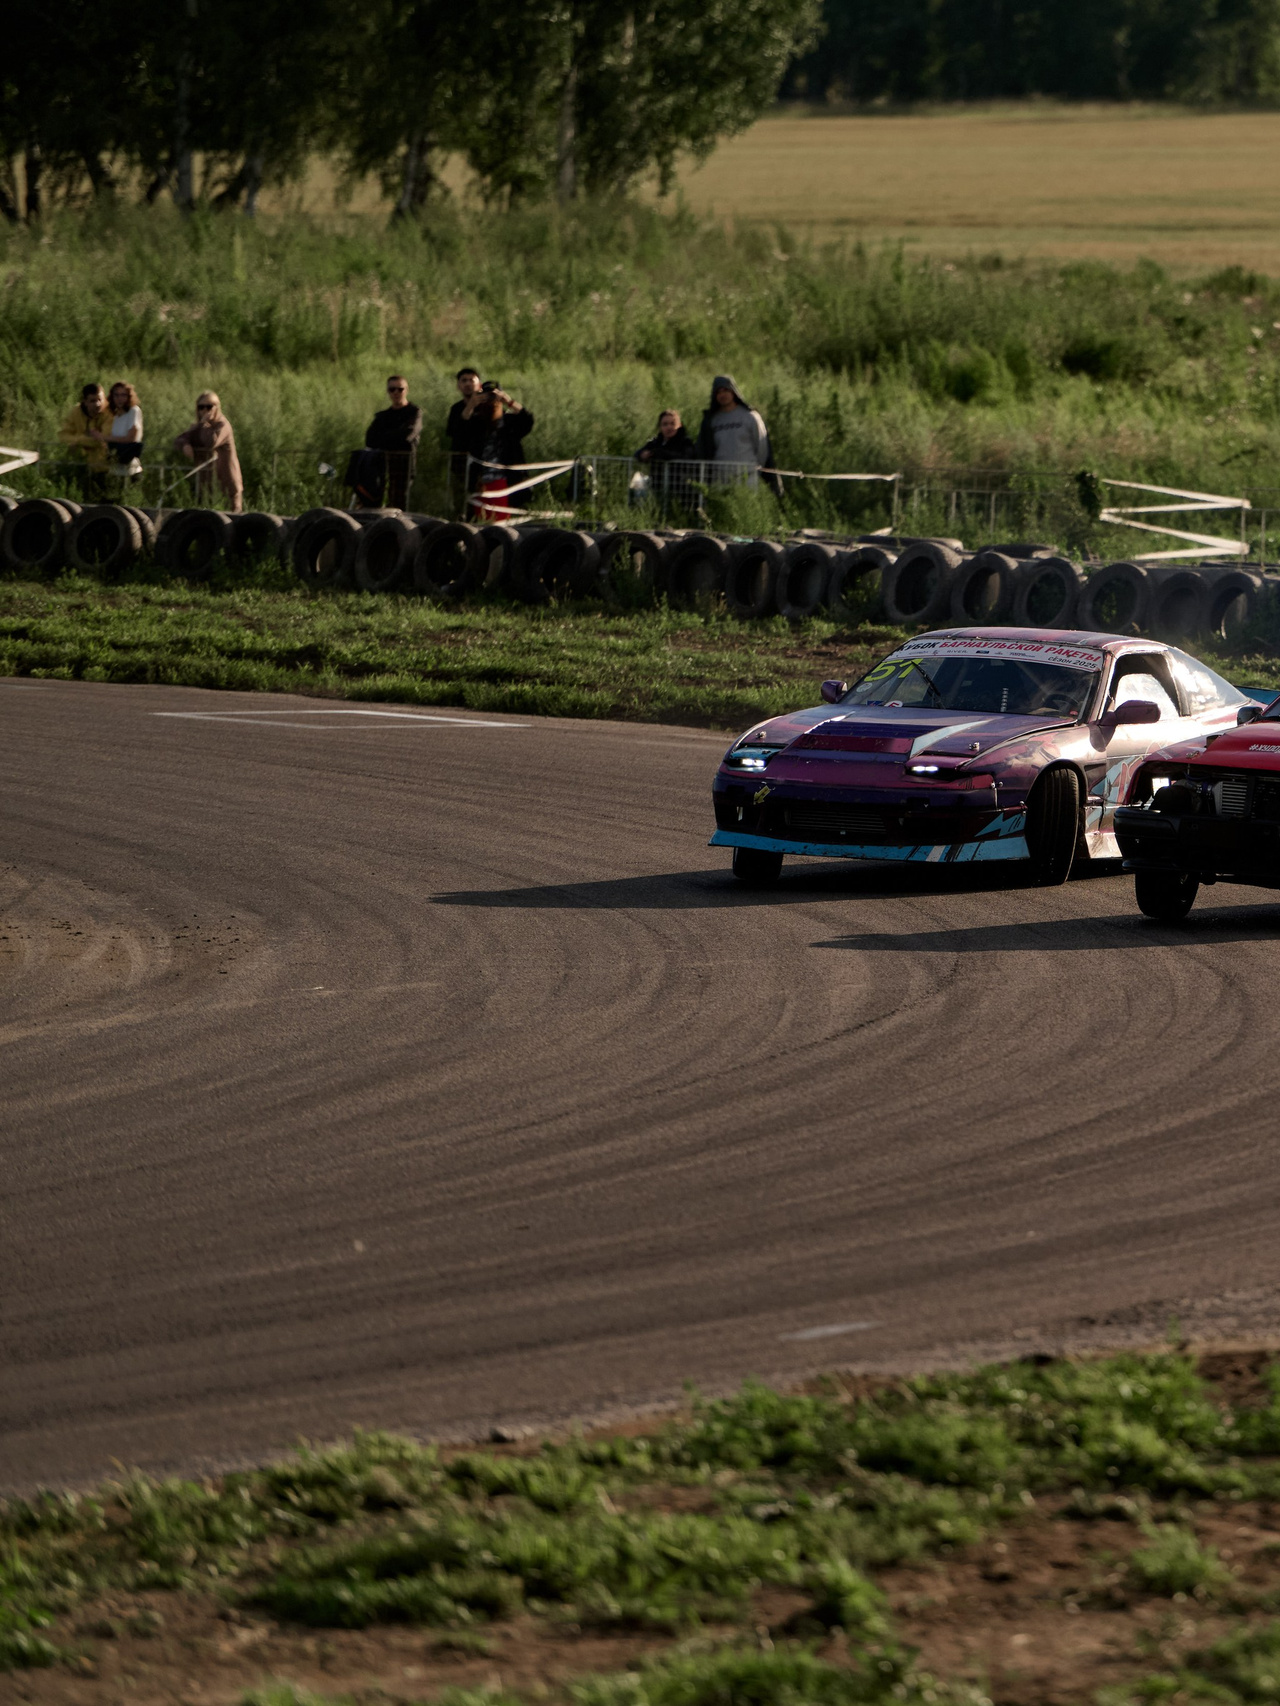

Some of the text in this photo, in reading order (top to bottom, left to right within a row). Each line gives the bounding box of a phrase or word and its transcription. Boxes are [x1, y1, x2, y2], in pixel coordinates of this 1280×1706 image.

[940, 641, 1044, 652] БАРНАУЛЬСКОЙ
[1045, 646, 1101, 662] РАКЕТЫ
[863, 658, 924, 682] 51
[1048, 656, 1097, 669] СЕЗОН 2025
